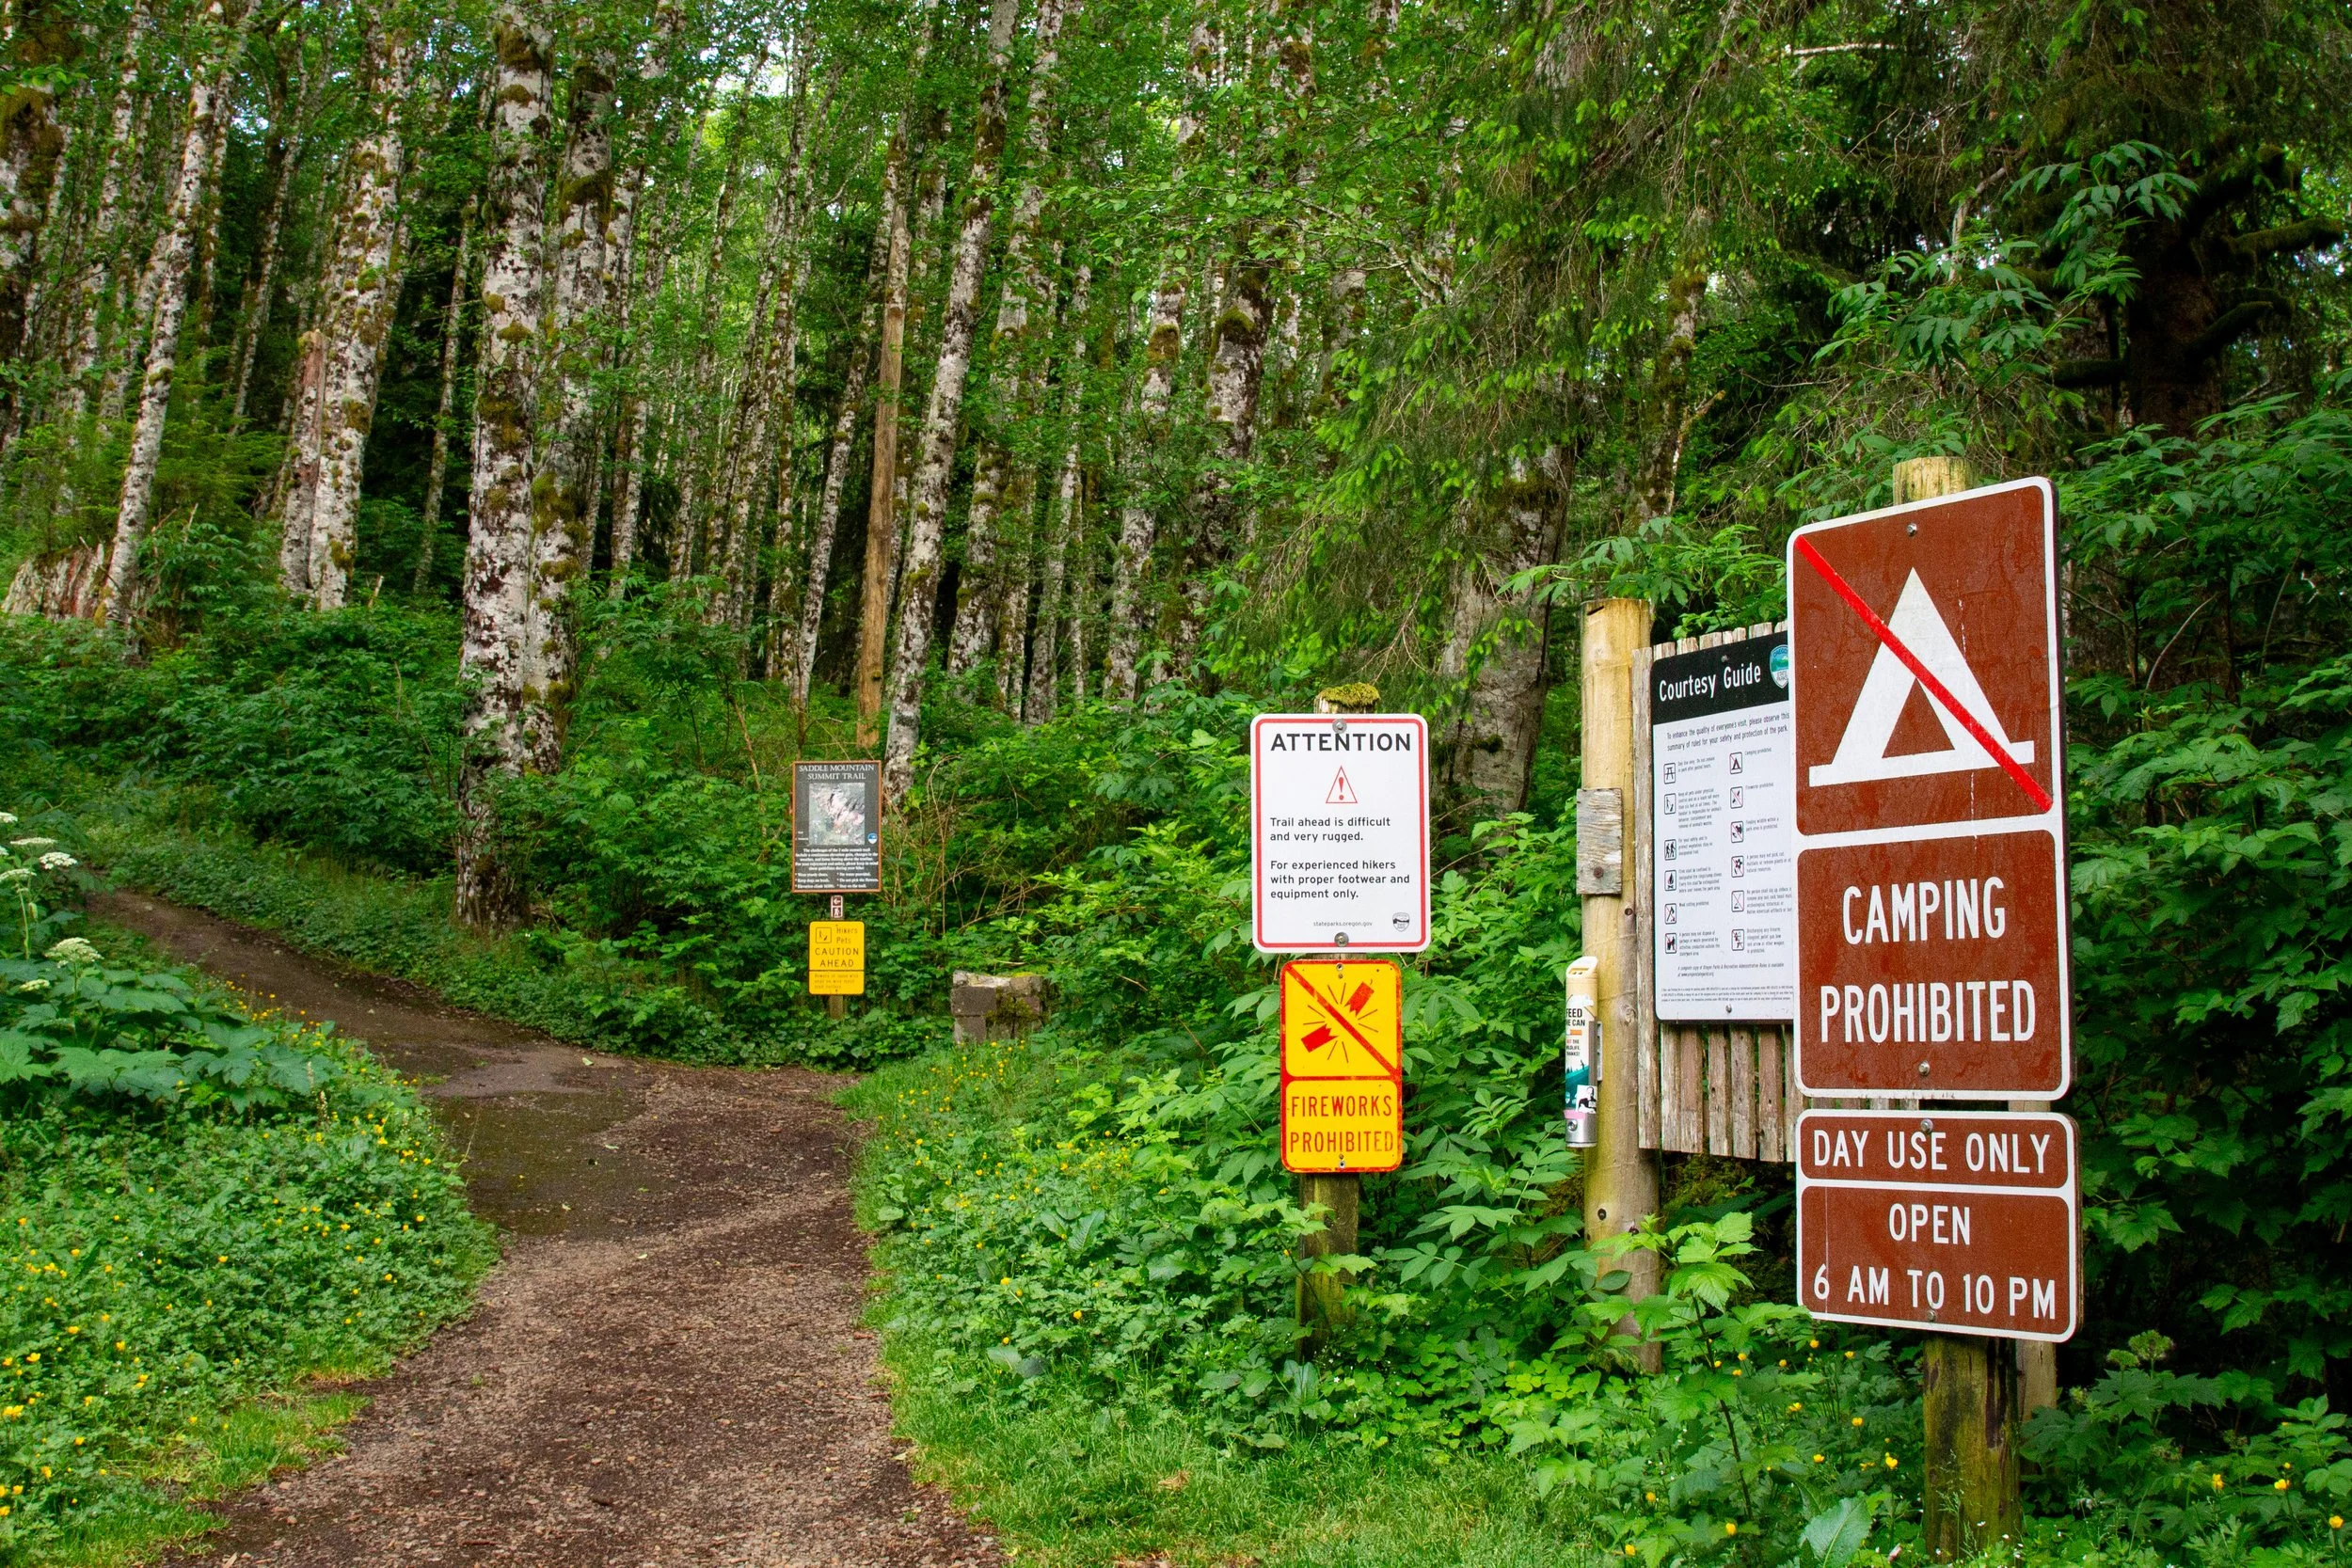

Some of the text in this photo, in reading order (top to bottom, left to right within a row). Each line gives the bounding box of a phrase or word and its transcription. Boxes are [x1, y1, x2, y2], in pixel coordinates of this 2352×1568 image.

[1659, 674, 1716, 702] Courtesy
[1724, 662, 1761, 689] Guide
[1749, 716, 1761, 727] please
[1763, 713, 1779, 722] observe
[1271, 733, 1410, 752] ATTENTION
[1708, 736, 1718, 746] your
[1719, 734, 1731, 744] safety
[1741, 729, 1762, 740] protection
[1270, 817, 1391, 827] Trail ahead is difficult
[1270, 832, 1363, 843] and very rugged.
[1270, 861, 1396, 871] For experienced hikers
[1271, 874, 1410, 885] with proper footwear and
[1271, 889, 1359, 899] equipment only.
[1843, 877, 2007, 946] CAMPING
[1820, 979, 2037, 1044] PROHIBITED
[1292, 1096, 1392, 1117] FIREWORKS
[1290, 1131, 1393, 1153] PROHIBITED
[1814, 1130, 2051, 1174] DAY USE ONLY
[1889, 1203, 1971, 1246] OPEN
[1813, 1264, 2056, 1321] 6 AM TO 10 PM
